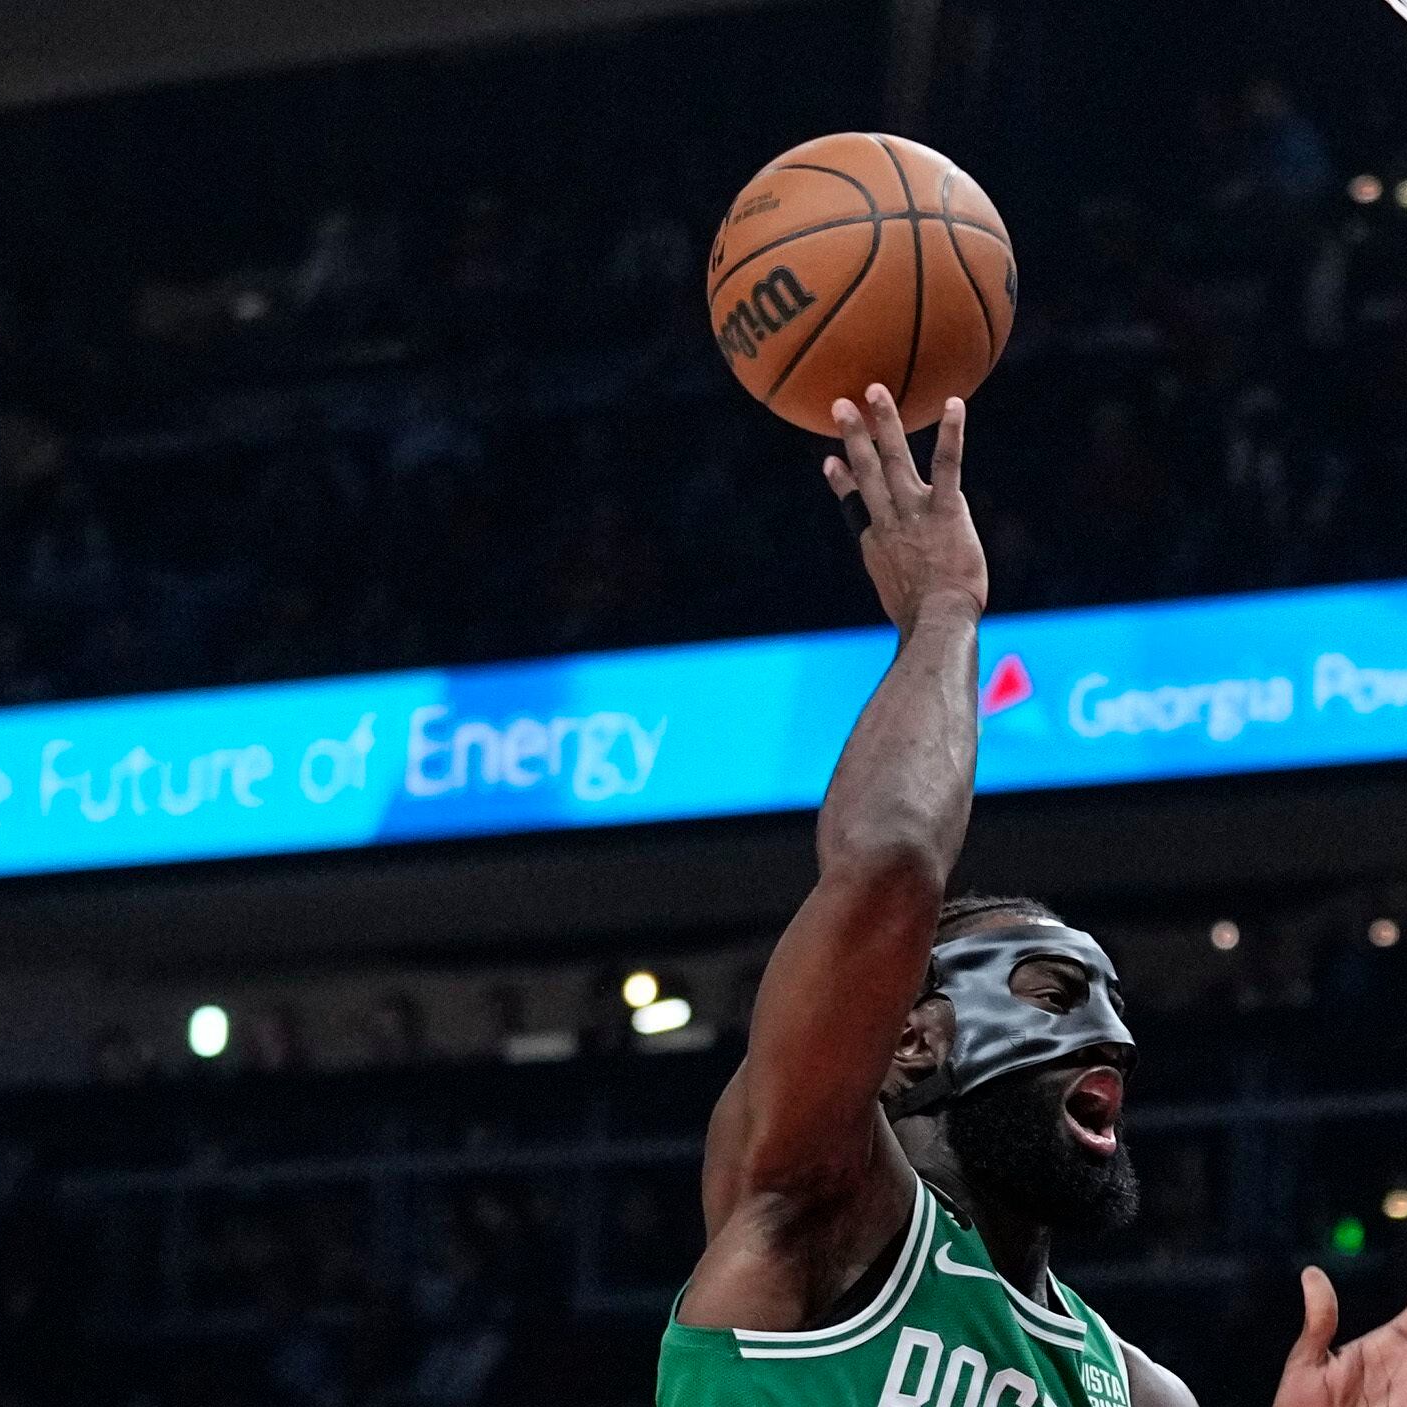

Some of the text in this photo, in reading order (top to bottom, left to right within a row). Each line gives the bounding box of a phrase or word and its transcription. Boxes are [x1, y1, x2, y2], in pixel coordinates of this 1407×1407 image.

[1068, 672, 1294, 742] Georgia
[39, 736, 273, 822] Future
[298, 711, 377, 803] of
[404, 703, 670, 803] Energy
[1082, 1361, 1127, 1406] ISTA
